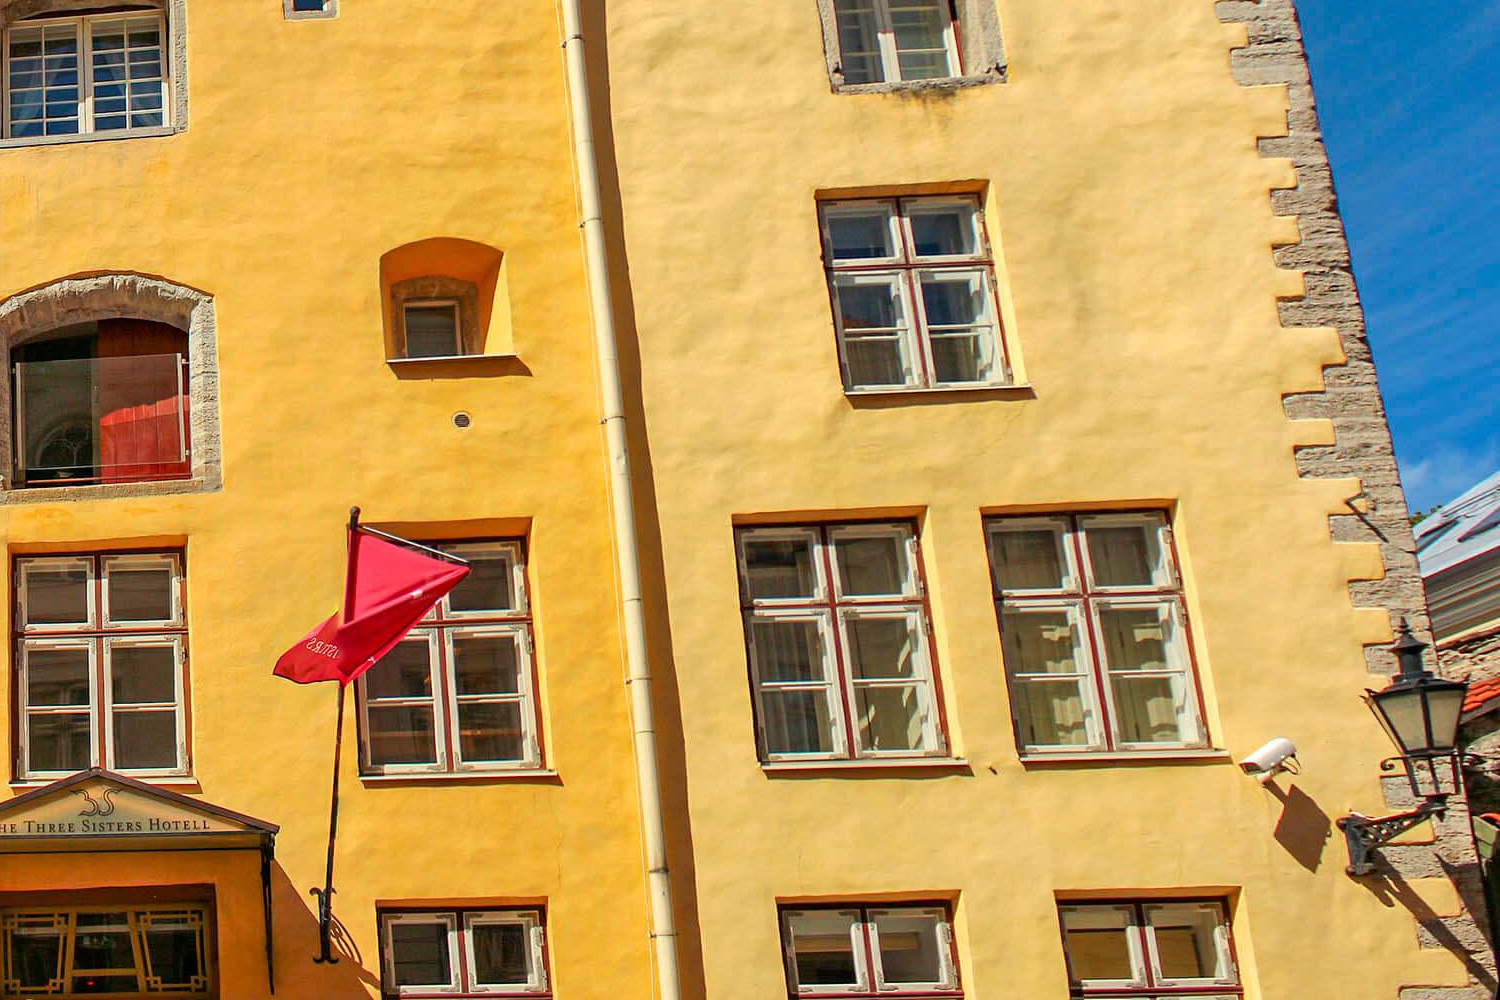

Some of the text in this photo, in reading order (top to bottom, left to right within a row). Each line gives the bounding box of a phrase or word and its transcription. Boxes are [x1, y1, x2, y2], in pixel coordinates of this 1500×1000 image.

[23, 820, 75, 833] THREE
[81, 819, 142, 833] SISTERS
[148, 818, 211, 832] HOTELL
